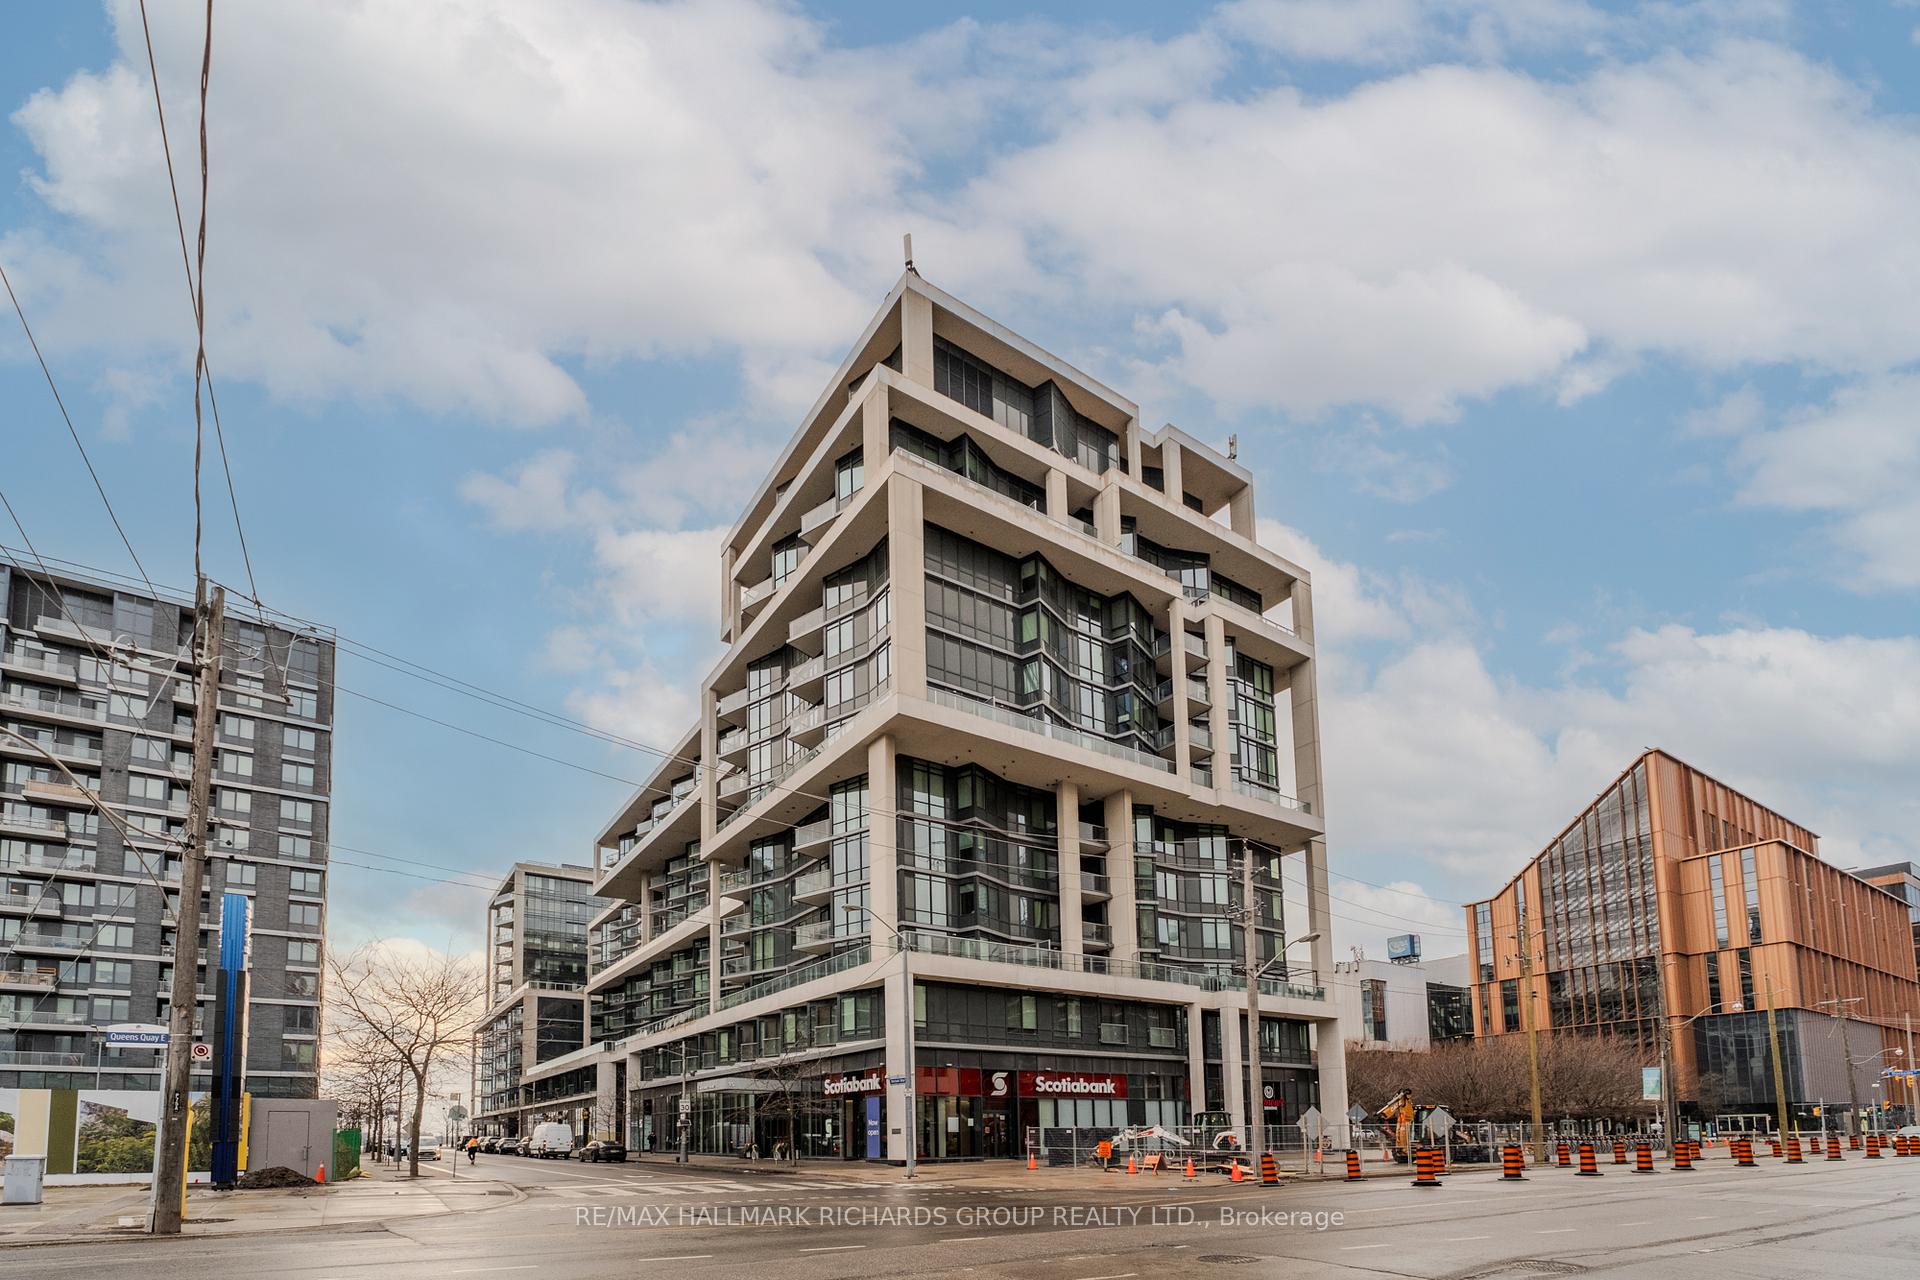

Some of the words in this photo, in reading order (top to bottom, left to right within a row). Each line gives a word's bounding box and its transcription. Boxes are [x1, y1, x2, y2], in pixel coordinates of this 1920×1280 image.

[110, 1032, 139, 1042] Queens
[140, 1033, 160, 1043] Quay
[161, 1034, 166, 1042] E
[824, 1073, 882, 1095] Scotiabank
[1035, 1076, 1116, 1094] Scotiabank
